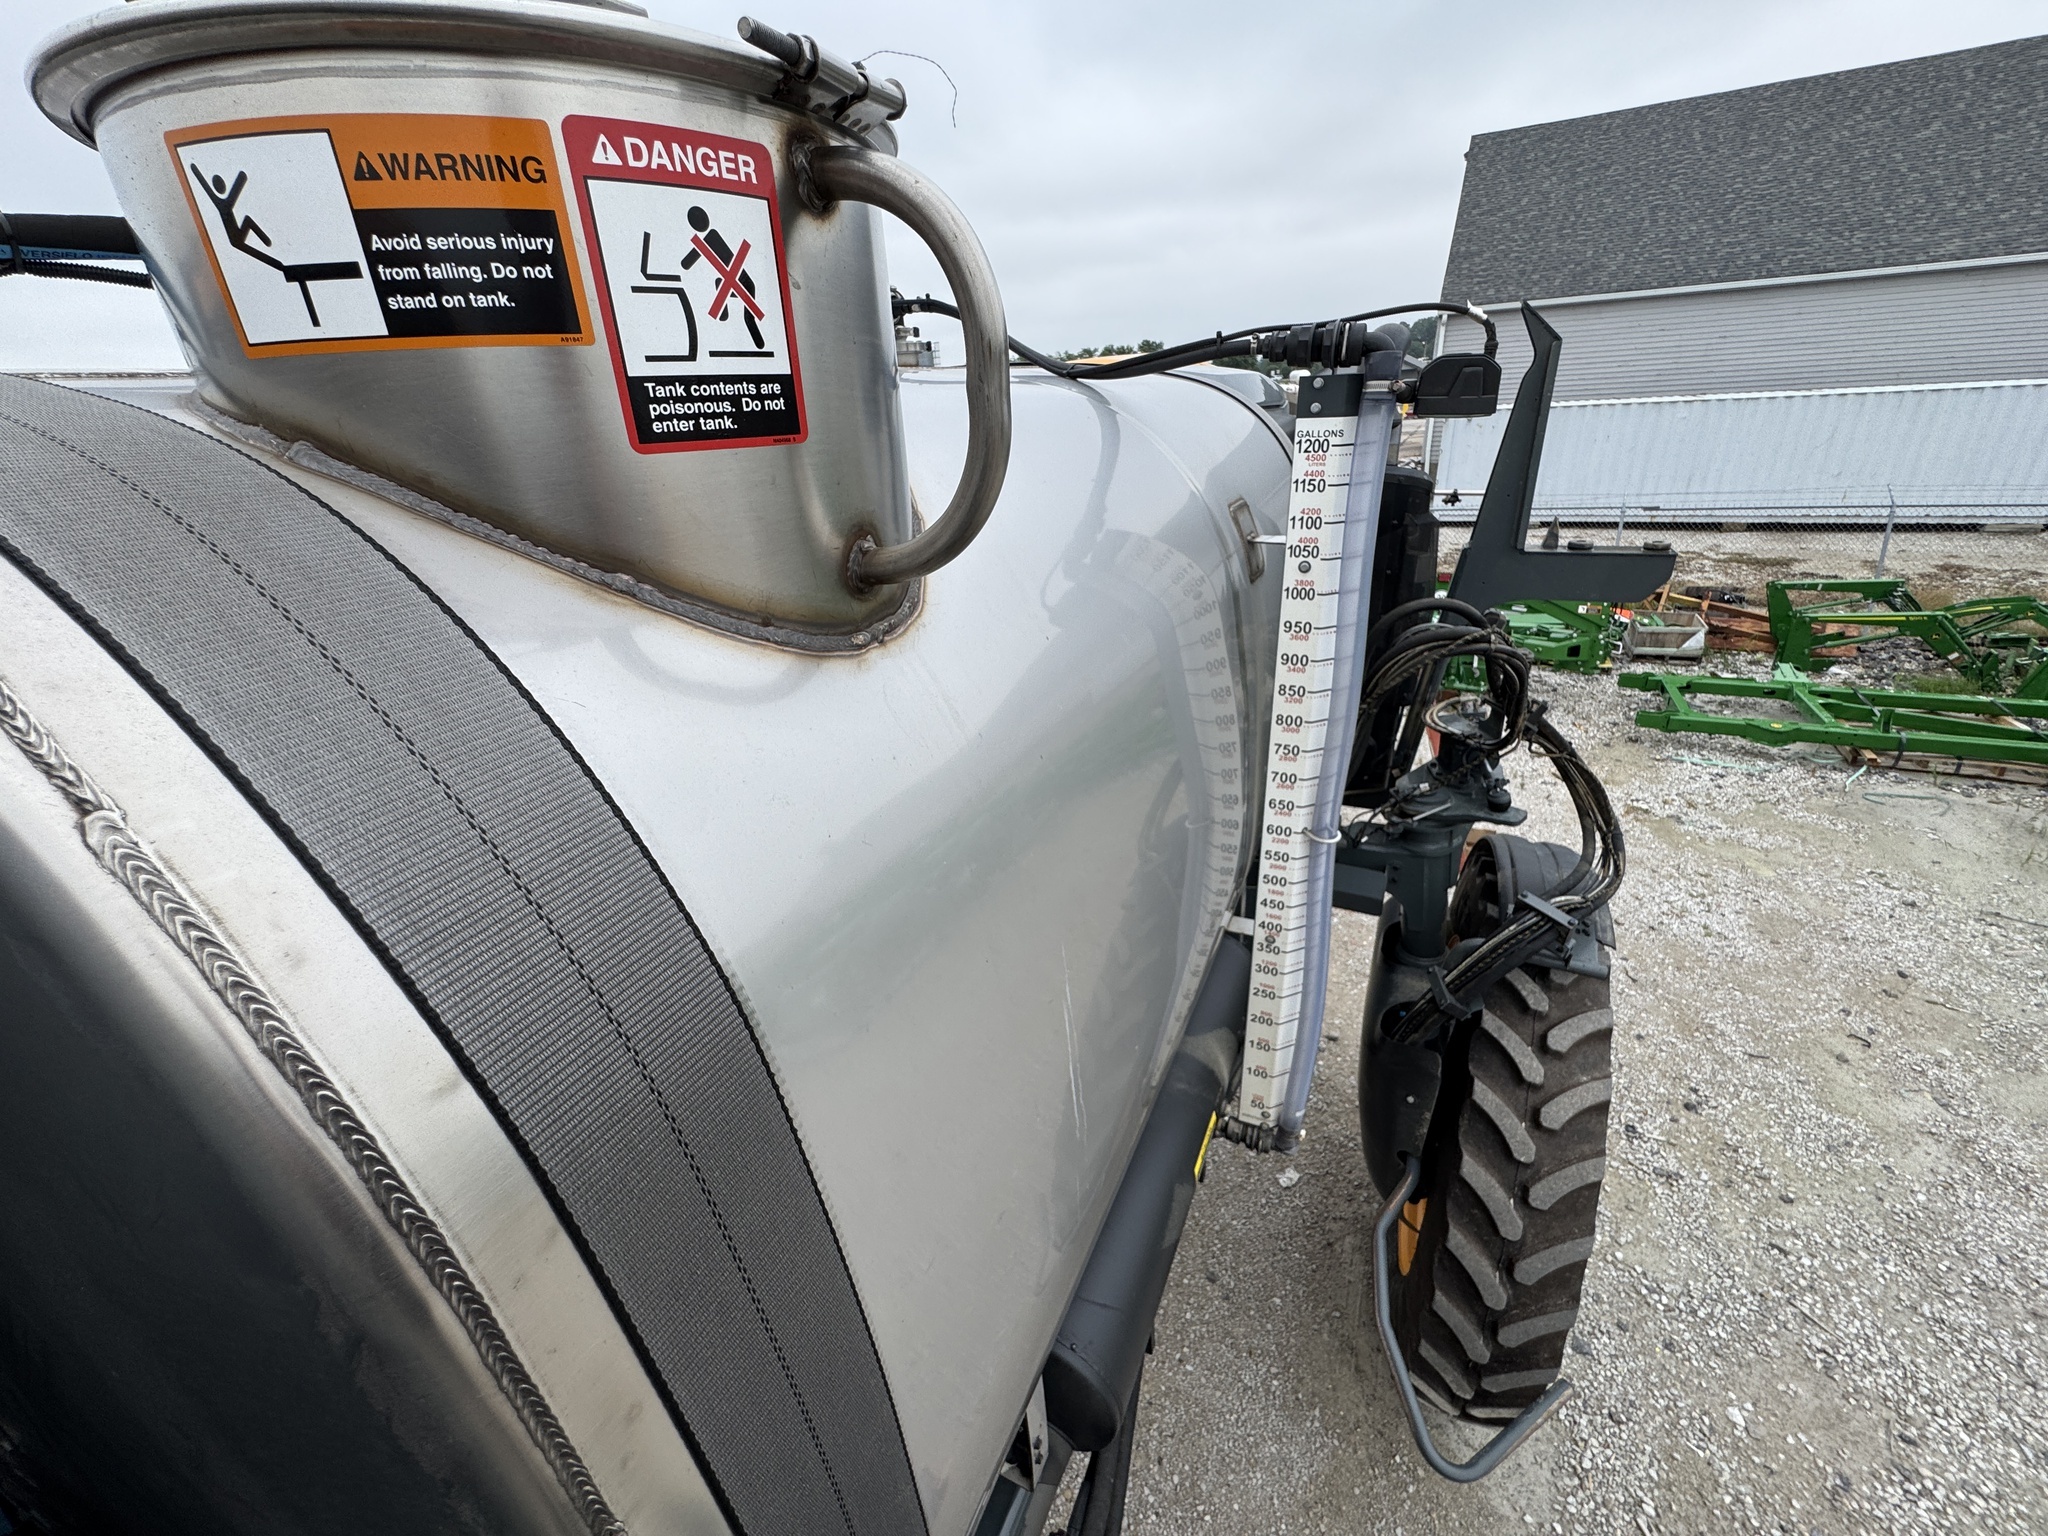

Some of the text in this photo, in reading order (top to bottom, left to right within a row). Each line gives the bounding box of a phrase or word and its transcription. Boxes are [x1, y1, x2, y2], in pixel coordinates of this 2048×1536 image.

[623, 136, 758, 184] DANGER
[377, 152, 547, 184] WARNING
[371, 232, 554, 254] Avoid serious injury
[378, 262, 554, 283] from falling. Do not
[387, 291, 516, 310] stand on tank.
[643, 381, 781, 398] Tank contents are
[648, 397, 786, 419] poisonous. Do not
[652, 415, 738, 433] enter tank.
[1297, 430, 1344, 438] GALLONS
[1296, 439, 1330, 453] 1200
[1293, 479, 1326, 493] 1150
[1290, 516, 1322, 530] 1100
[1287, 544, 1320, 558] 1050
[1284, 586, 1315, 601] 1000
[1283, 620, 1312, 634] 950
[1281, 653, 1309, 667] 900
[1278, 684, 1306, 698] 850
[1275, 714, 1303, 728] 800
[1274, 743, 1300, 756] 750
[1271, 771, 1298, 785] 700
[1268, 798, 1295, 811] 650
[1266, 824, 1292, 837] 600
[1264, 849, 1289, 863] 550
[1262, 874, 1287, 887] 500
[1260, 898, 1285, 911] 450
[1258, 921, 1282, 933] 400
[1256, 942, 1280, 955] 350
[1255, 963, 1278, 976] 300
[1252, 987, 1276, 1000] 250
[1250, 1013, 1274, 1026] 200
[1249, 1040, 1271, 1052] 150
[1246, 1067, 1268, 1079] 100
[1250, 1100, 1265, 1110] 50
